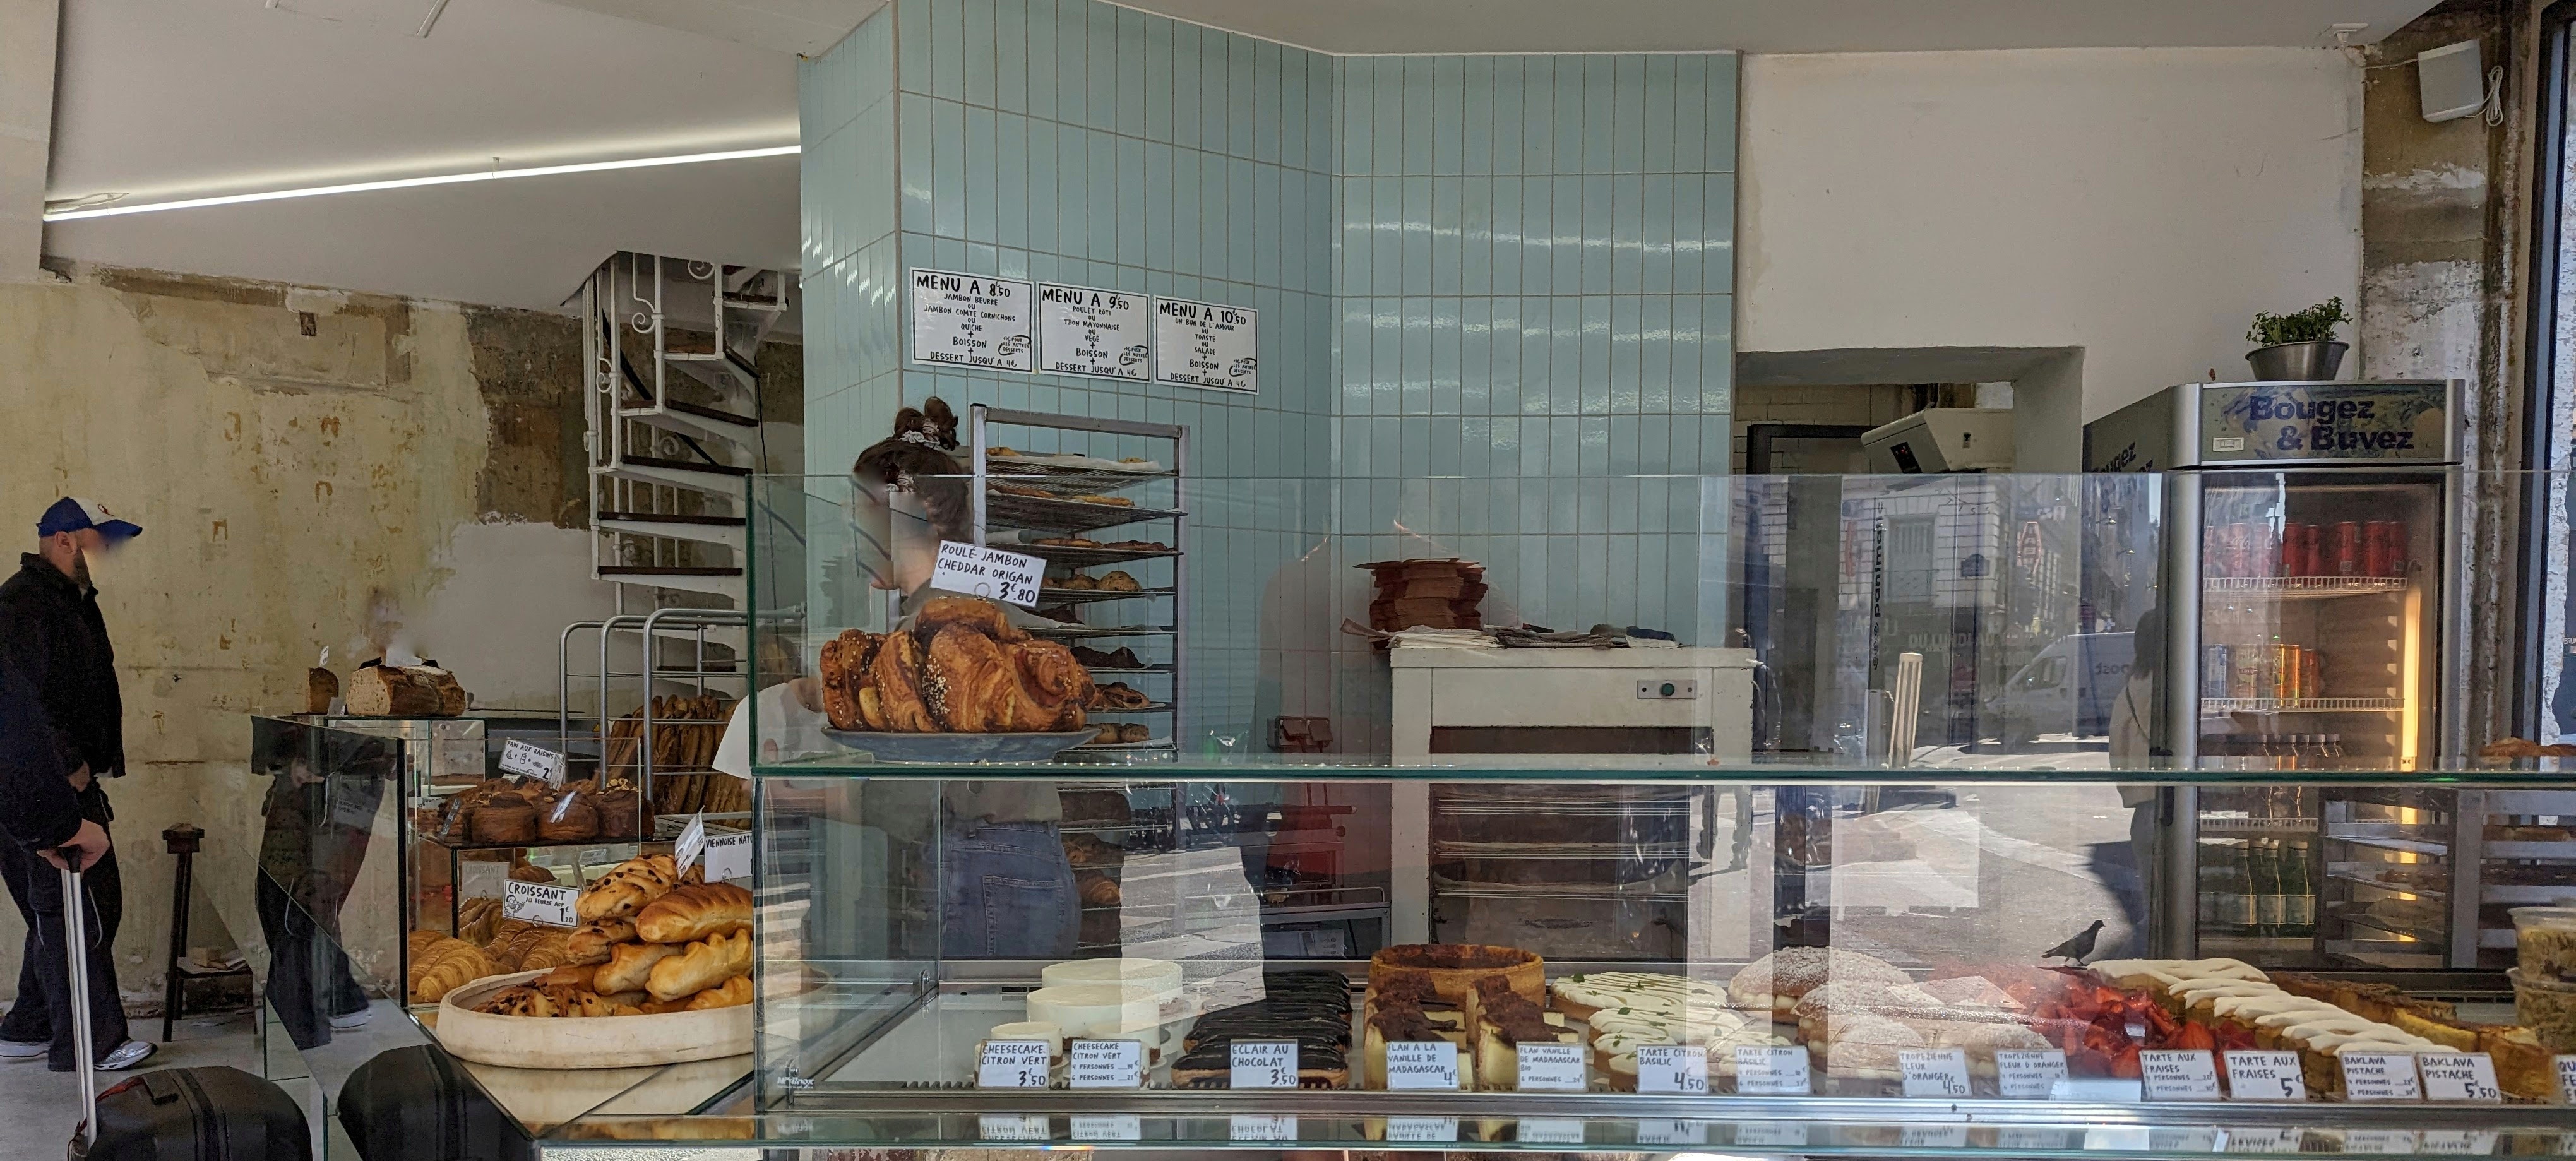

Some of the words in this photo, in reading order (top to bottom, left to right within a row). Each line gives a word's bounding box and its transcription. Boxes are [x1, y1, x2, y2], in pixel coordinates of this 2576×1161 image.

[917, 275, 960, 292] MENU
[970, 280, 980, 295] A
[944, 293, 971, 302] JAMBON
[975, 297, 998, 306] BEURRE
[1042, 289, 1082, 304] MENU
[1091, 293, 1100, 307] A
[924, 306, 952, 314] JAMBON
[981, 312, 1015, 322] CORNICHONS
[1160, 302, 1196, 318] MENU
[1204, 307, 1213, 321] A
[1083, 321, 1119, 331] MAYONNAISE
[953, 337, 987, 348] BOISSON
[931, 352, 964, 362] DESSERT
[1076, 348, 1108, 359] BOISSON
[1056, 362, 1086, 372] DESSERT
[1190, 359, 1219, 370] BOISSON
[1171, 372, 1199, 382] DESSERT
[2250, 396, 2375, 424] Bougez
[2277, 426, 2303, 450] &
[2311, 426, 2414, 450] Buvez
[941, 544, 977, 559] ROULÉ
[981, 551, 1027, 568] JAMBON
[938, 558, 986, 576] CHEDDAR
[993, 569, 1032, 584] ORIGAN
[534, 749, 554, 759] RAISINS
[706, 837, 736, 848] VIENNOISE
[509, 883, 566, 900] CROISSANT
[983, 1045, 1043, 1054] CHEESECAKE
[1232, 1045, 1268, 1054] ECLAIR
[1274, 1045, 1288, 1054] AU
[982, 1056, 1015, 1064] CITRON
[1022, 1056, 1046, 1064] VERT
[1232, 1057, 1283, 1067] CHOCOLAT
[1640, 1057, 1672, 1066] BASILIC
[2230, 1056, 2267, 1066] TARTE
[2274, 1057, 2296, 1066] AUX
[2423, 1057, 2474, 1067] BAKLAVA
[2233, 1069, 2275, 1079] FRAISES
[2426, 1070, 2474, 1080] PISTACHE
